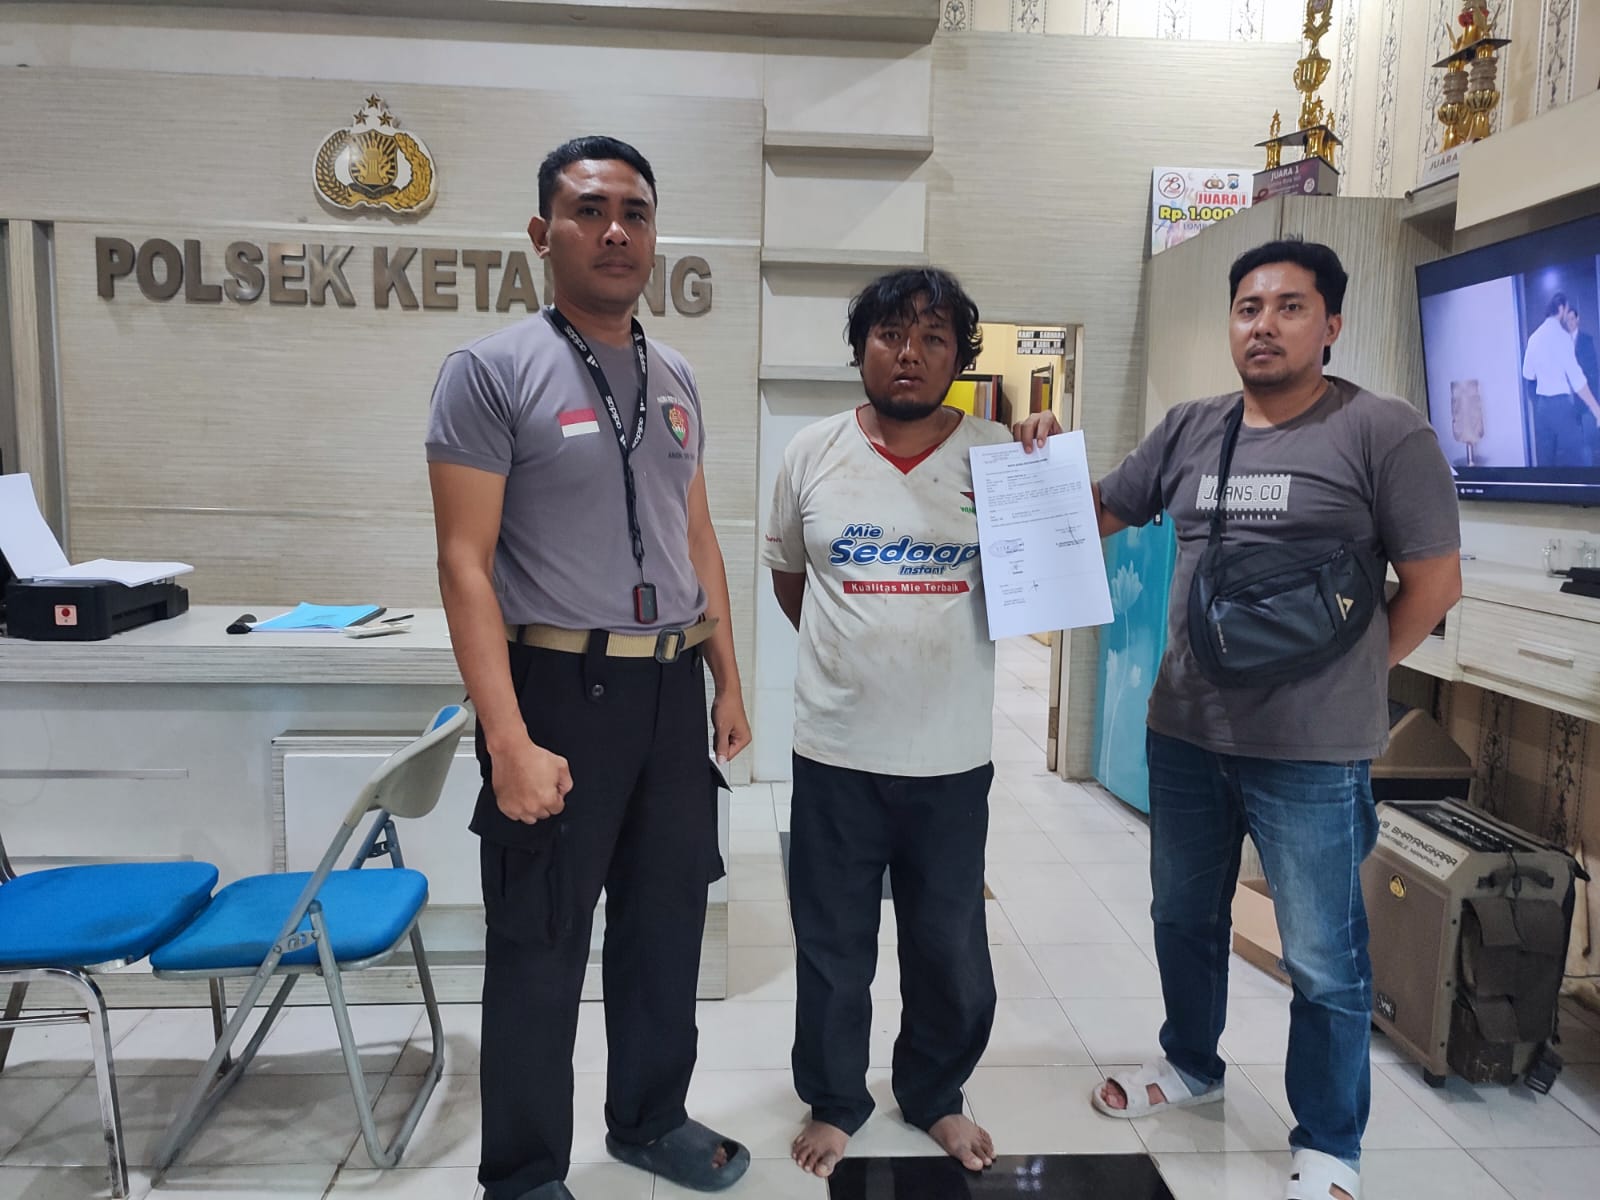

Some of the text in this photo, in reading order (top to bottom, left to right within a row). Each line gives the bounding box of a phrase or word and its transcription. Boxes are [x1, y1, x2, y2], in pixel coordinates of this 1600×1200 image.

[1271, 167, 1293, 181] JUARA
[1198, 193, 1238, 205] JUARA
[1159, 205, 1238, 222] Rp. 1.000
[95, 236, 713, 318] POLSEK KETANG
[605, 395, 622, 430] adidas
[844, 525, 882, 538] Mie
[830, 537, 979, 567] Sedaap
[851, 582, 959, 592] Kualitas Mie Terbaik
